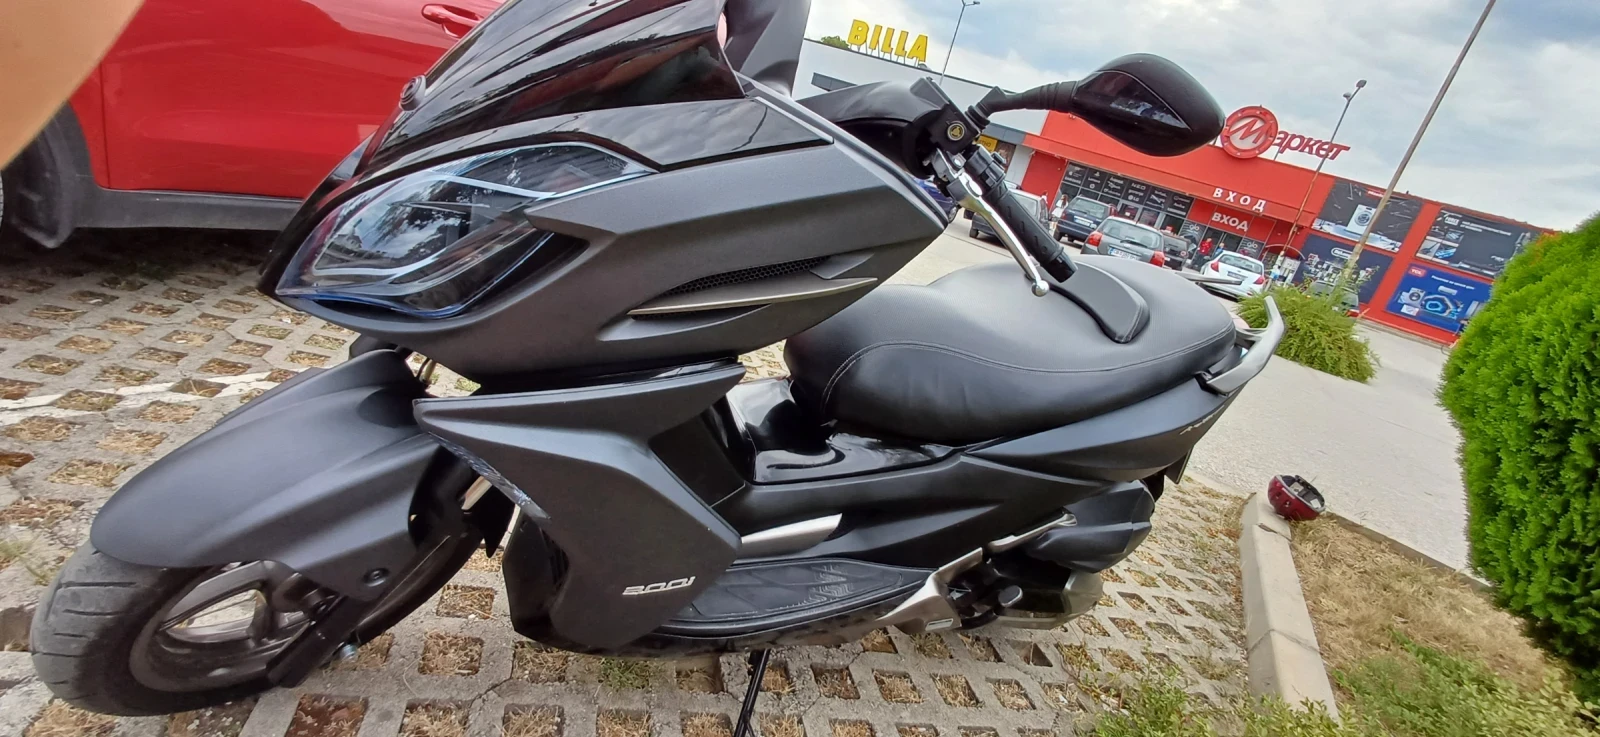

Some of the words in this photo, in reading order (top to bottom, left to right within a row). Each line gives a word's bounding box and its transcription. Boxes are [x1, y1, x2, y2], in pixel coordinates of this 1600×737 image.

[847, 19, 928, 62] BILLA
[1212, 187, 1266, 212] ВХОД
[1211, 212, 1249, 232] ВХОД
